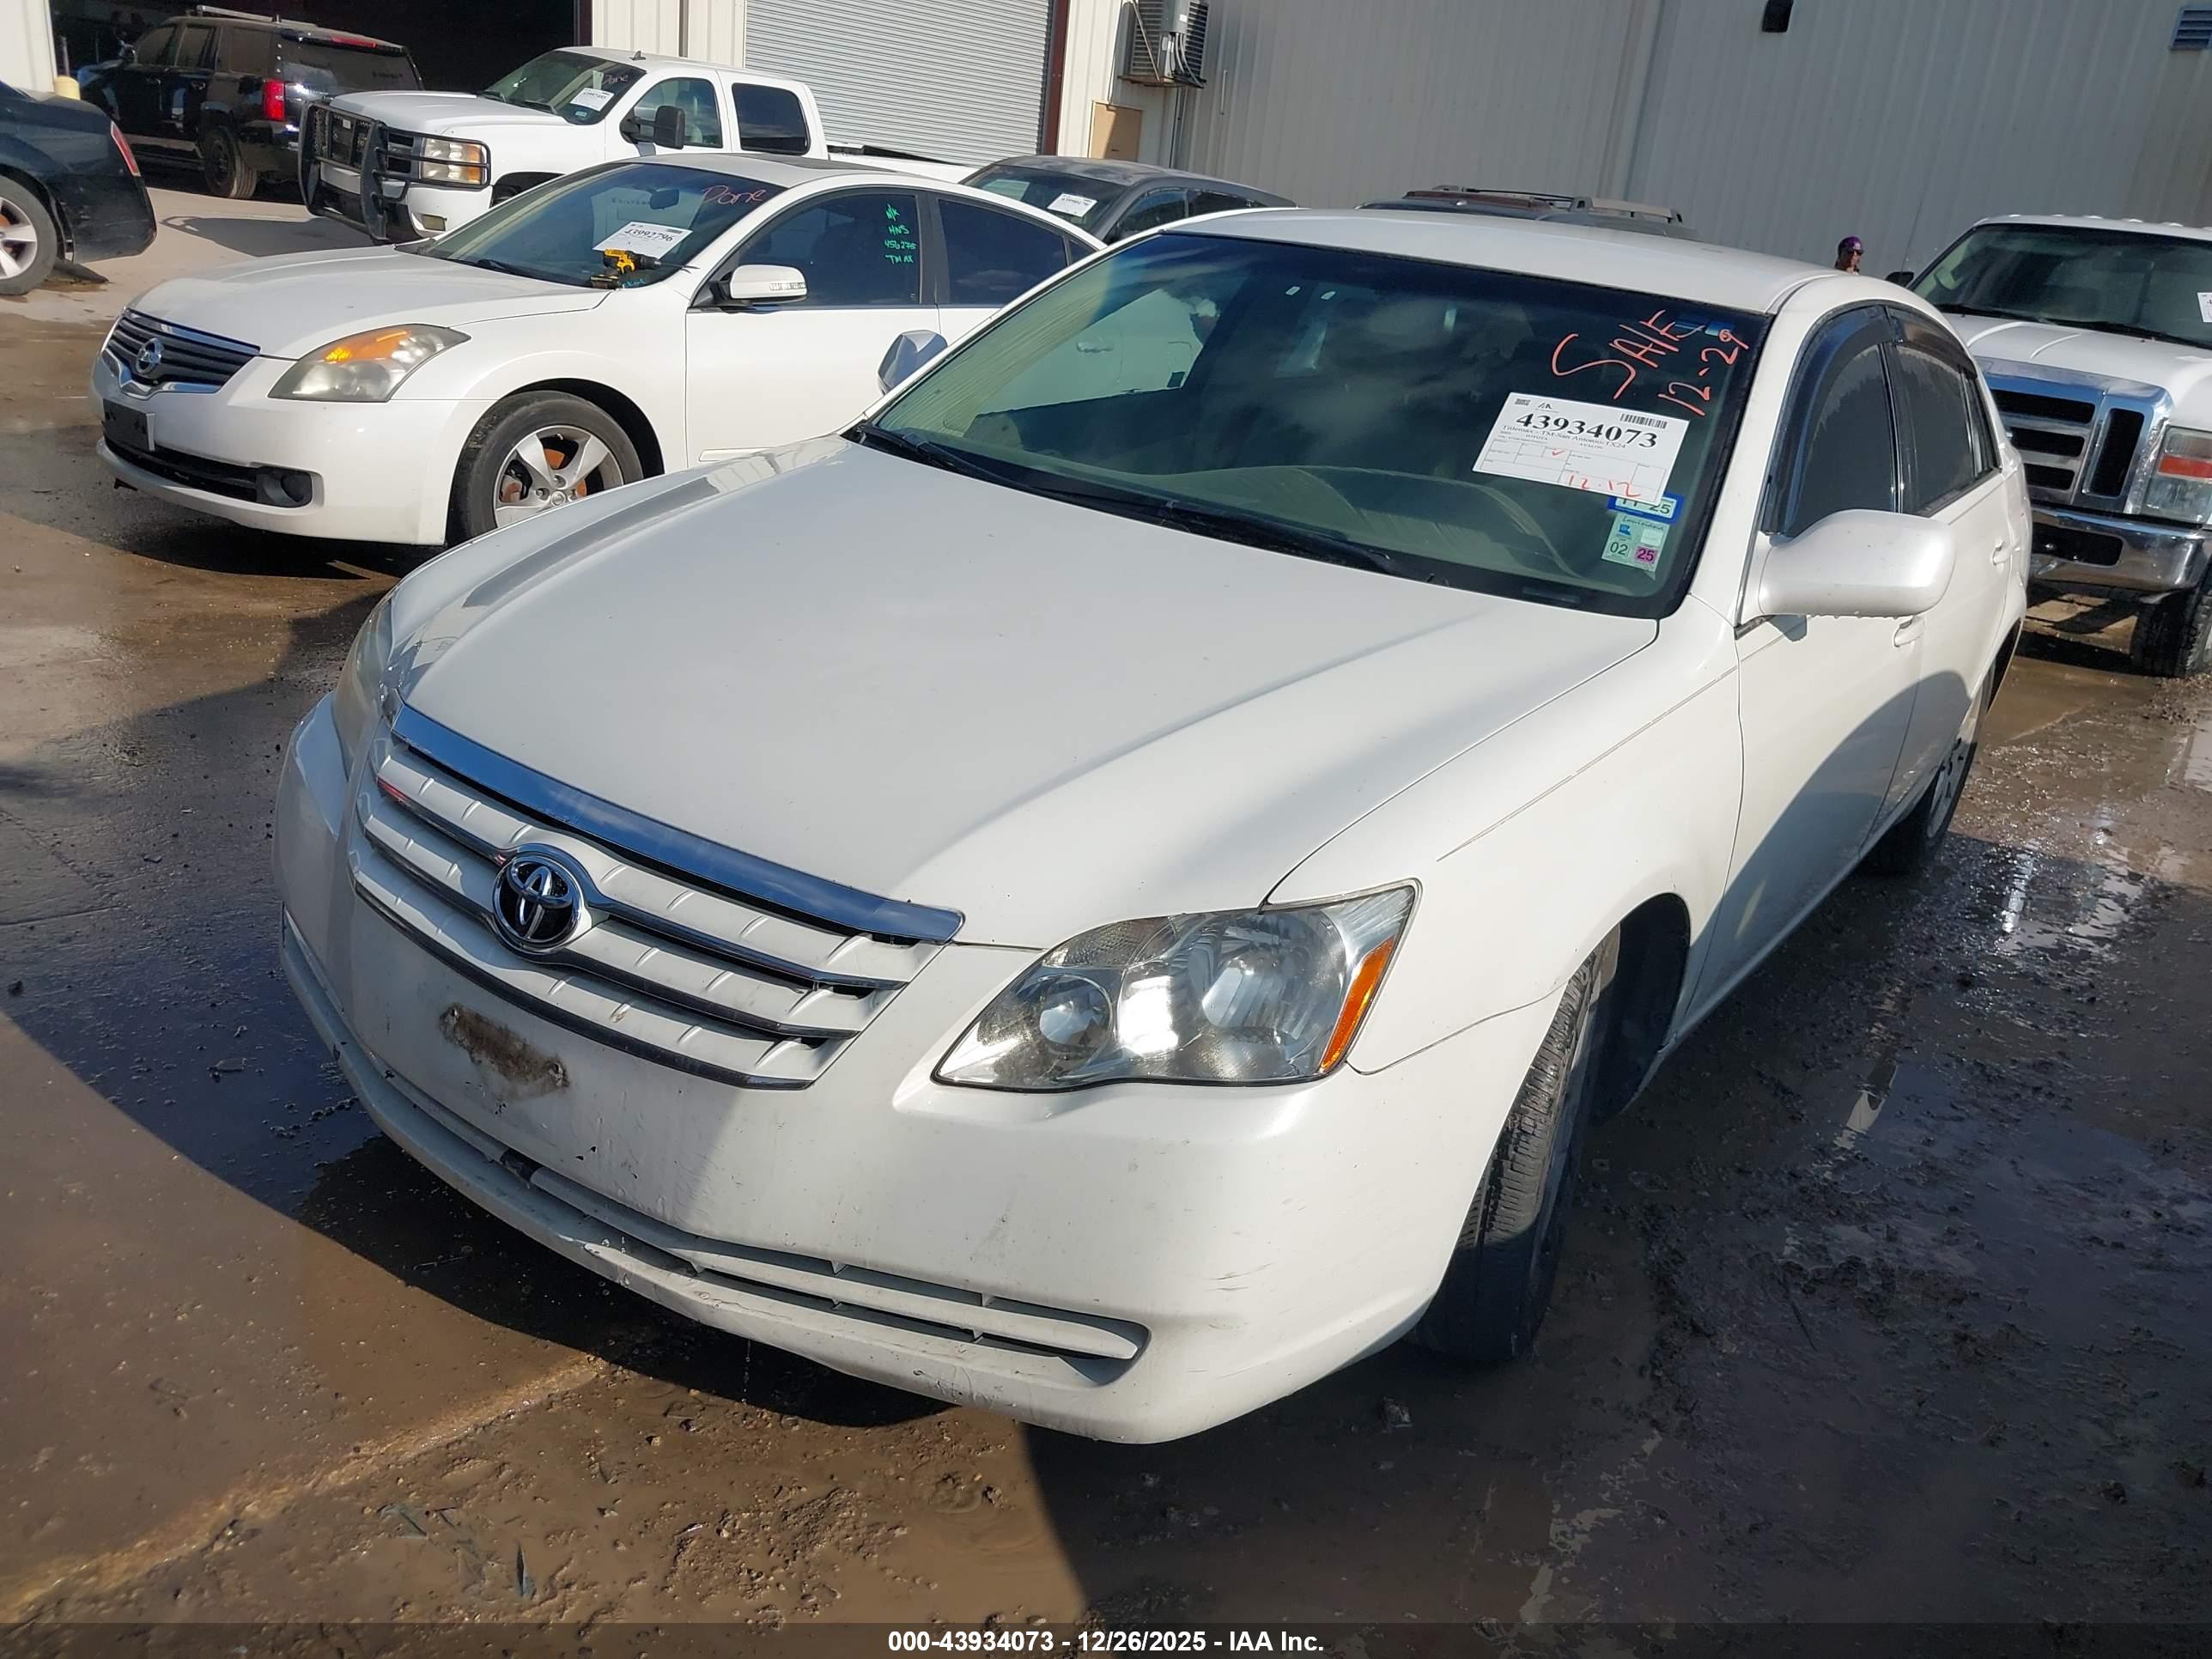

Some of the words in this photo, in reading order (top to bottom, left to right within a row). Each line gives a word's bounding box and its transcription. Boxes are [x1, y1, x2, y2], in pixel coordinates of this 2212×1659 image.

[1516, 412, 1658, 449] 43934073
[1609, 541, 1629, 556] 02
[1637, 548, 1656, 562] 25
